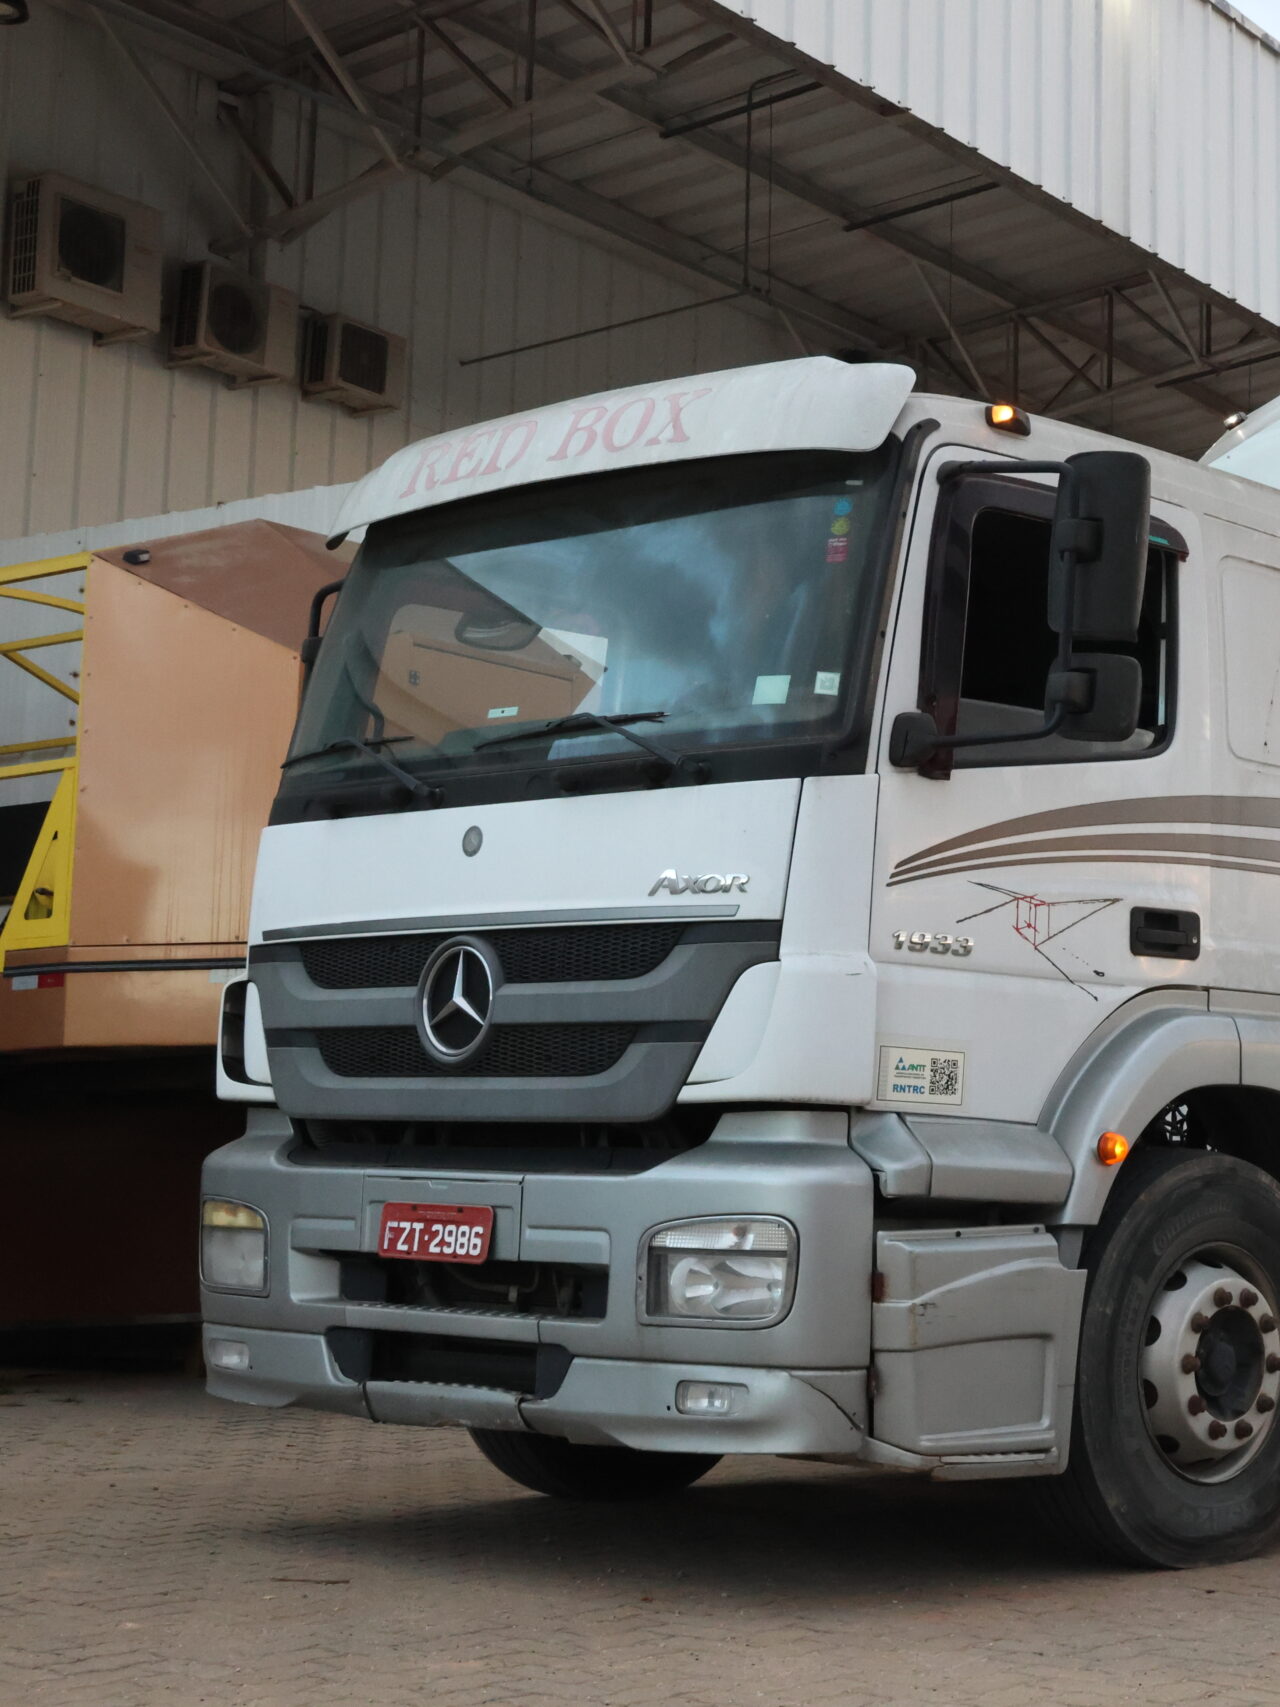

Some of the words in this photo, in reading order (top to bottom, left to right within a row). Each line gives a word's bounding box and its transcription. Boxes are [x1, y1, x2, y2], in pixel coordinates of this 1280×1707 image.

[400, 420, 538, 499] RED
[547, 388, 712, 461] BOX
[891, 929, 975, 957] 1933
[892, 1083, 926, 1095] RNTRC
